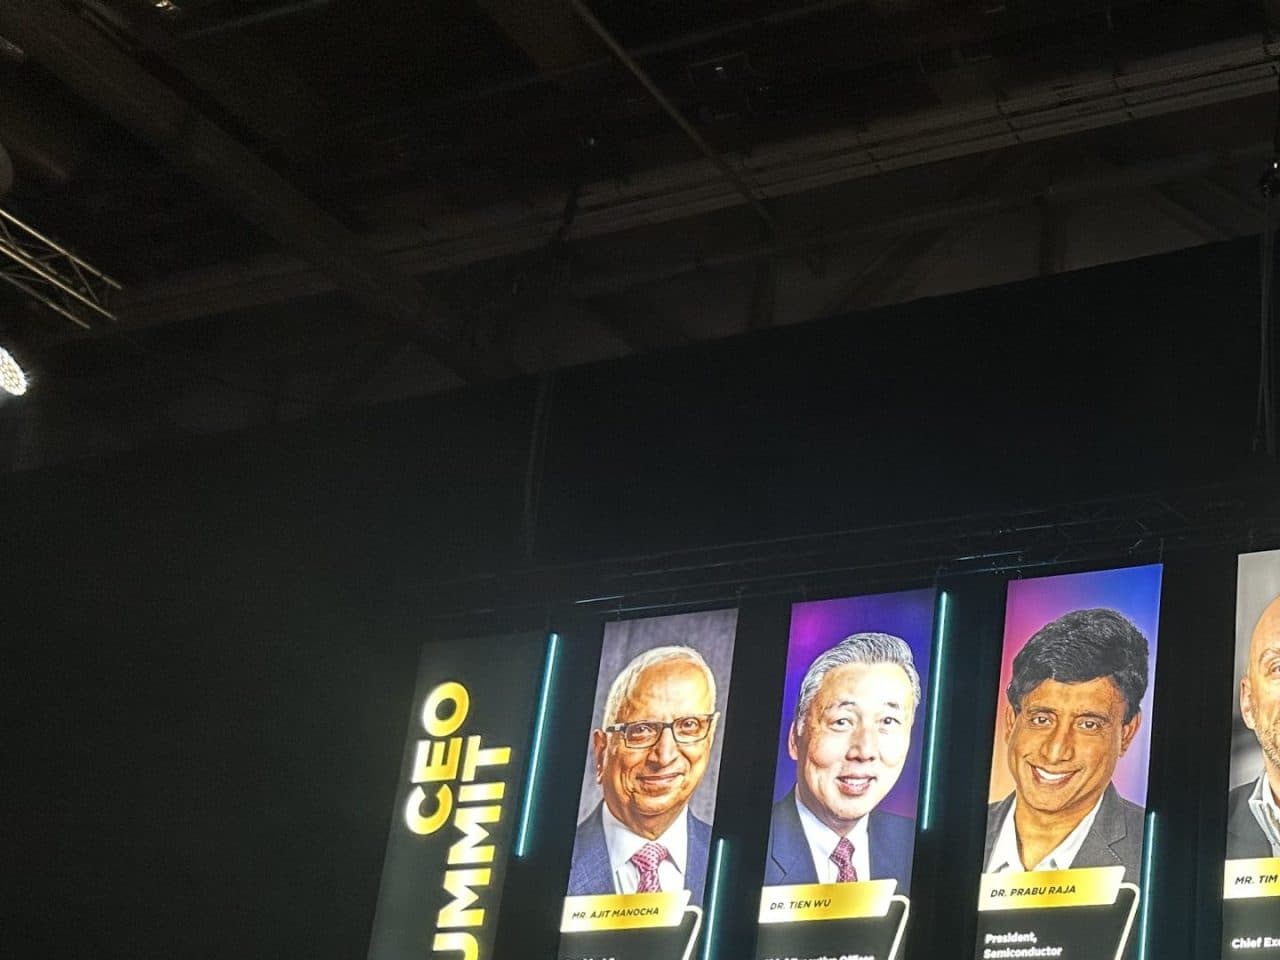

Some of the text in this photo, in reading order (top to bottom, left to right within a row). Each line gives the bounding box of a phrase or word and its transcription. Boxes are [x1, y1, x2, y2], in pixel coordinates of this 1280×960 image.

[405, 681, 471, 836] CEO
[1235, 875, 1255, 885] MR.
[1258, 874, 1278, 884] TIM
[990, 885, 1076, 898] DR. PRABU RAJA
[770, 899, 832, 910] DR. TIEN WU
[590, 909, 611, 919] AJIT
[612, 907, 660, 918] MANOCHA
[984, 932, 1037, 945] President,
[1231, 937, 1262, 949] Chief
[983, 946, 1063, 960] Semiconductor
